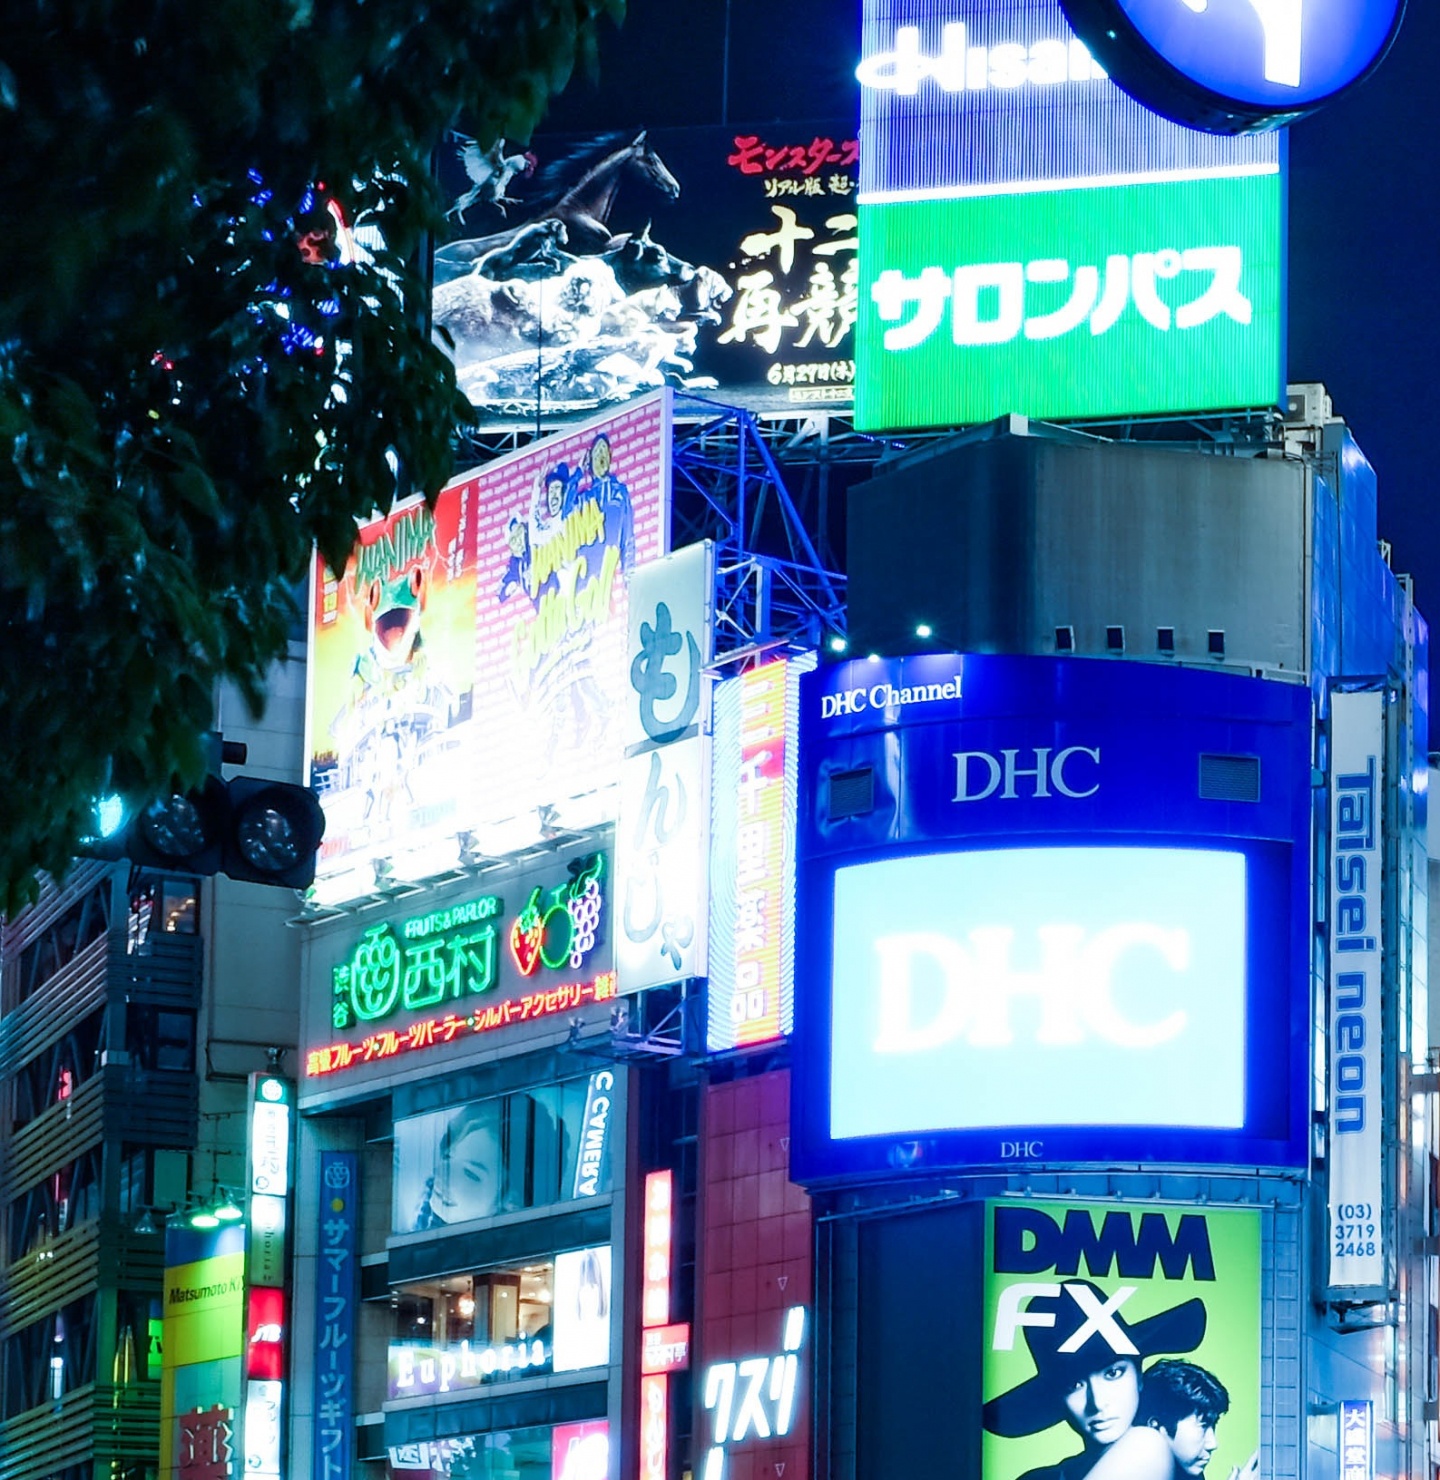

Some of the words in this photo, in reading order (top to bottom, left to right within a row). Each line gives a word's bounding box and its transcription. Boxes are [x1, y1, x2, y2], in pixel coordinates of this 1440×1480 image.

[871, 246, 1252, 351] サロンパス
[821, 688, 867, 719] DHC
[869, 676, 963, 710] Channel
[952, 746, 1101, 802] DHC
[1336, 755, 1376, 953] Taisei
[404, 925, 494, 1010] 西村
[872, 923, 1190, 1054] DHC
[1336, 971, 1366, 1134] neon
[1000, 1141, 1044, 1158] DHC
[993, 1206, 1217, 1281] DMM
[1335, 1224, 1376, 1240] 3719
[1337, 1203, 1373, 1222] (03)
[1335, 1241, 1376, 1258] 2468
[992, 1282, 1141, 1356] FX
[396, 1331, 546, 1393] Euphoria
